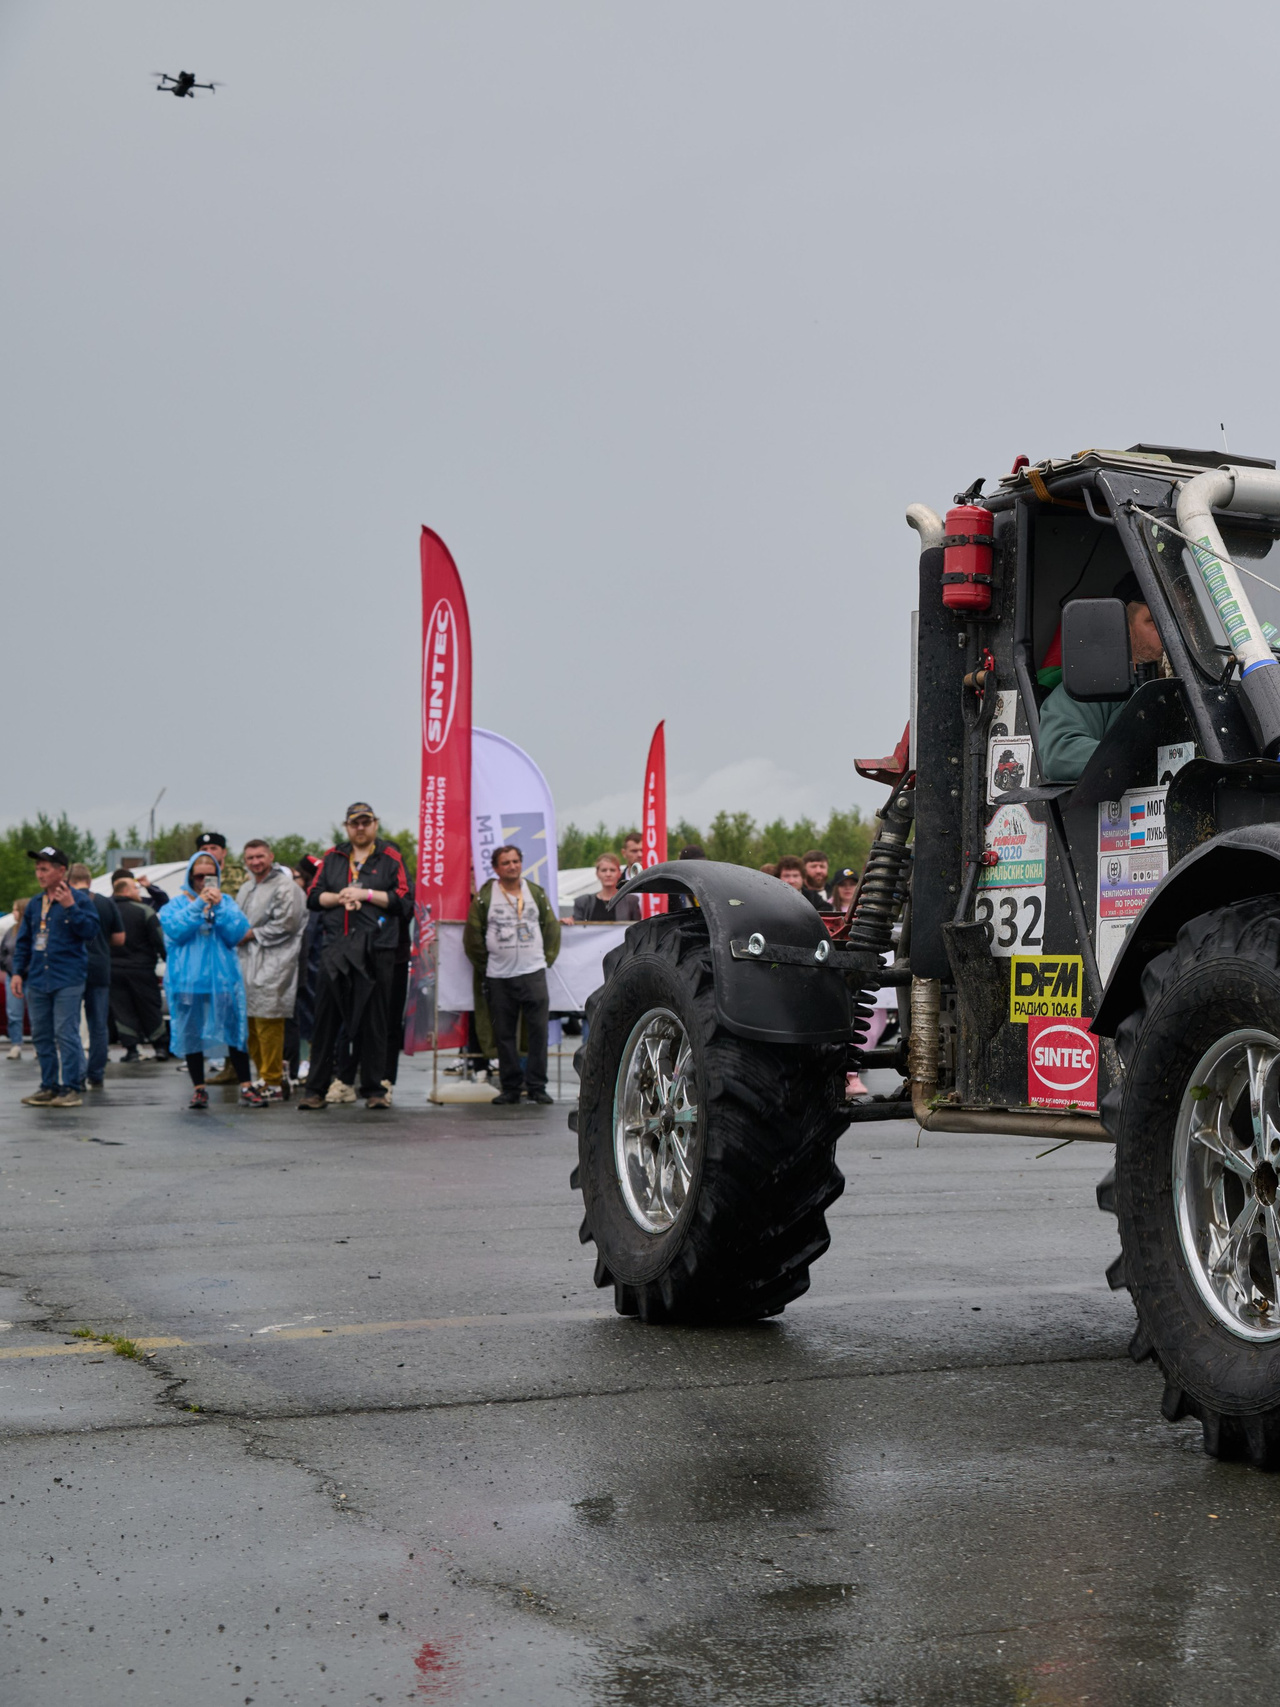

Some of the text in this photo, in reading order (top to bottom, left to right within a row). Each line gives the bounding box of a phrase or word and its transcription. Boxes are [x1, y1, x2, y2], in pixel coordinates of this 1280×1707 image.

[428, 609, 450, 743] SINTEC
[421, 774, 436, 887] АНТИФРИЗЫ
[433, 775, 447, 887] АВТОХИМИЯ
[997, 846, 1023, 861] 2020
[1025, 863, 1043, 879] ОКНА
[1102, 889, 1133, 898] ЧЕМПИОНАТ
[1014, 962, 1079, 997] DFM
[1014, 1002, 1077, 1017] РАДИО 104.6
[1034, 1046, 1092, 1069] SINTEC
